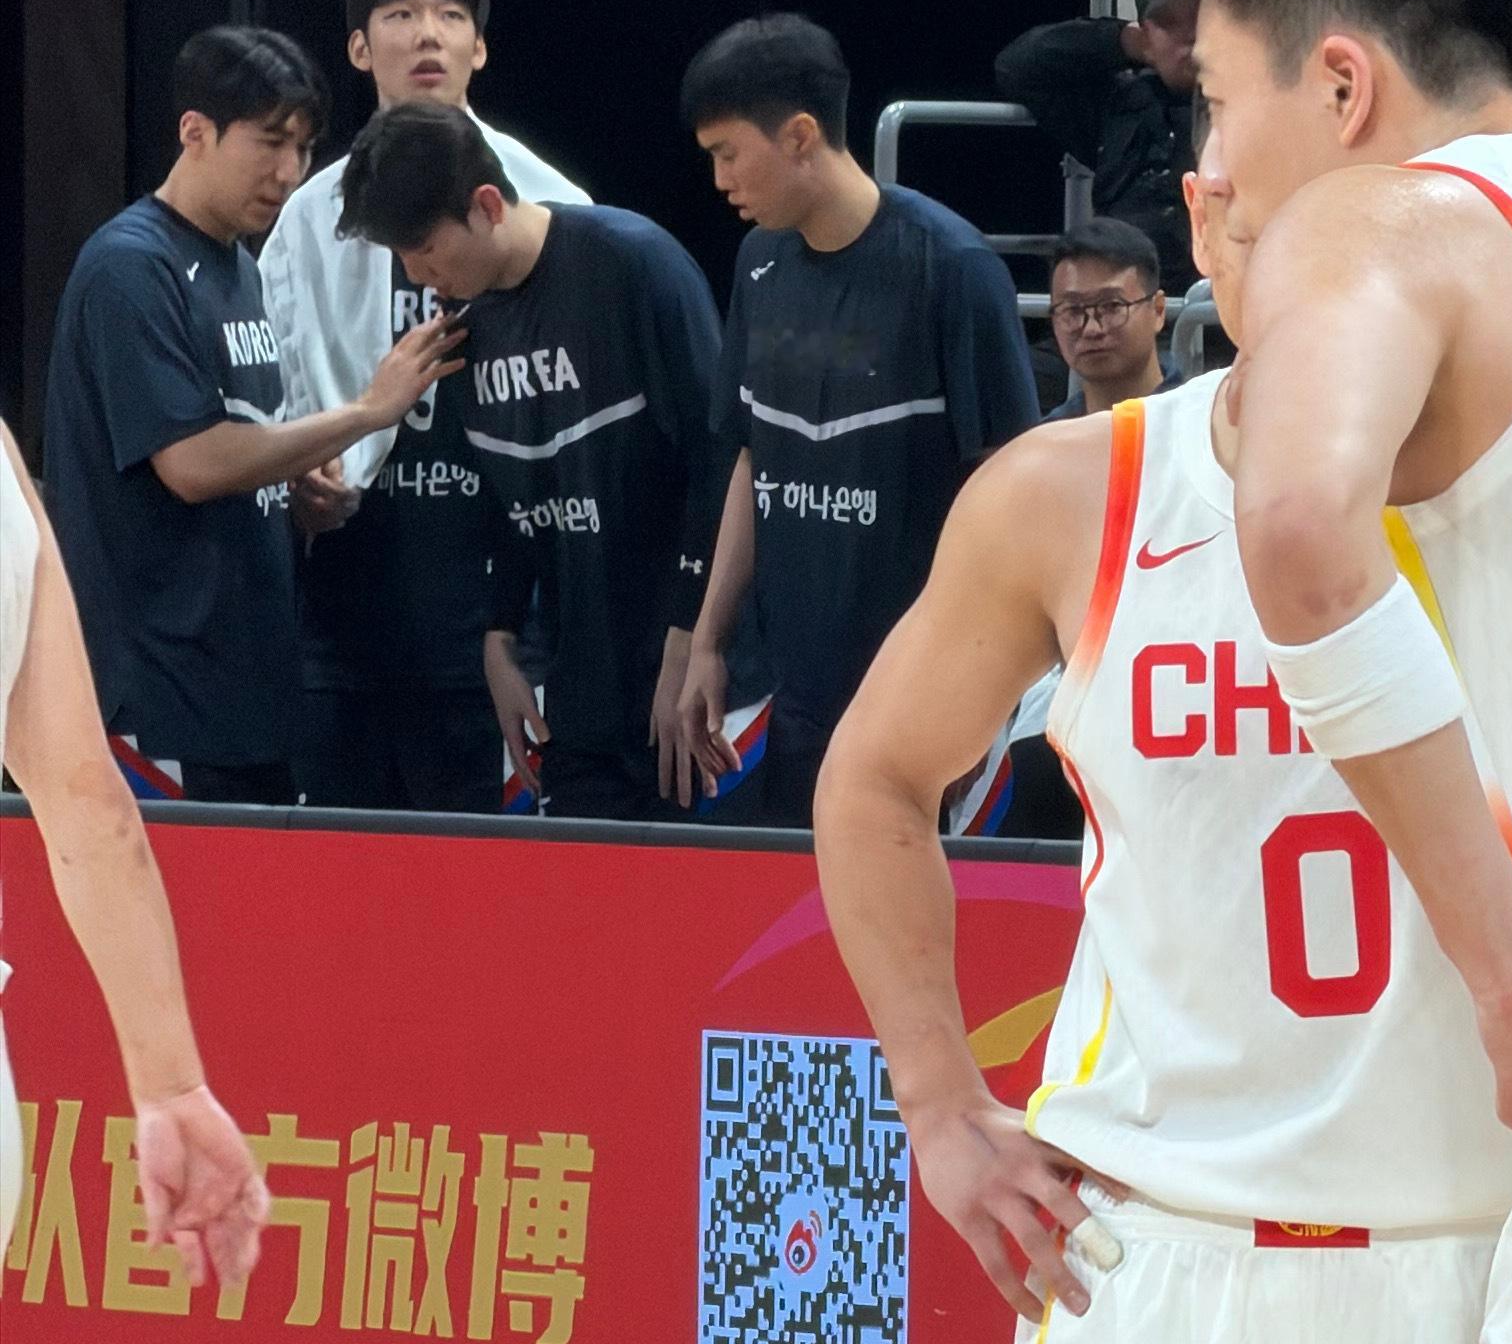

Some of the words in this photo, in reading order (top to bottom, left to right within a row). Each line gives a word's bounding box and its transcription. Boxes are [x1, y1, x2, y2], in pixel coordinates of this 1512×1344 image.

[473, 346, 581, 405] KOREA
[783, 481, 877, 525] 하나은행
[1132, 640, 1315, 759] CH
[1260, 810, 1392, 1018] 0
